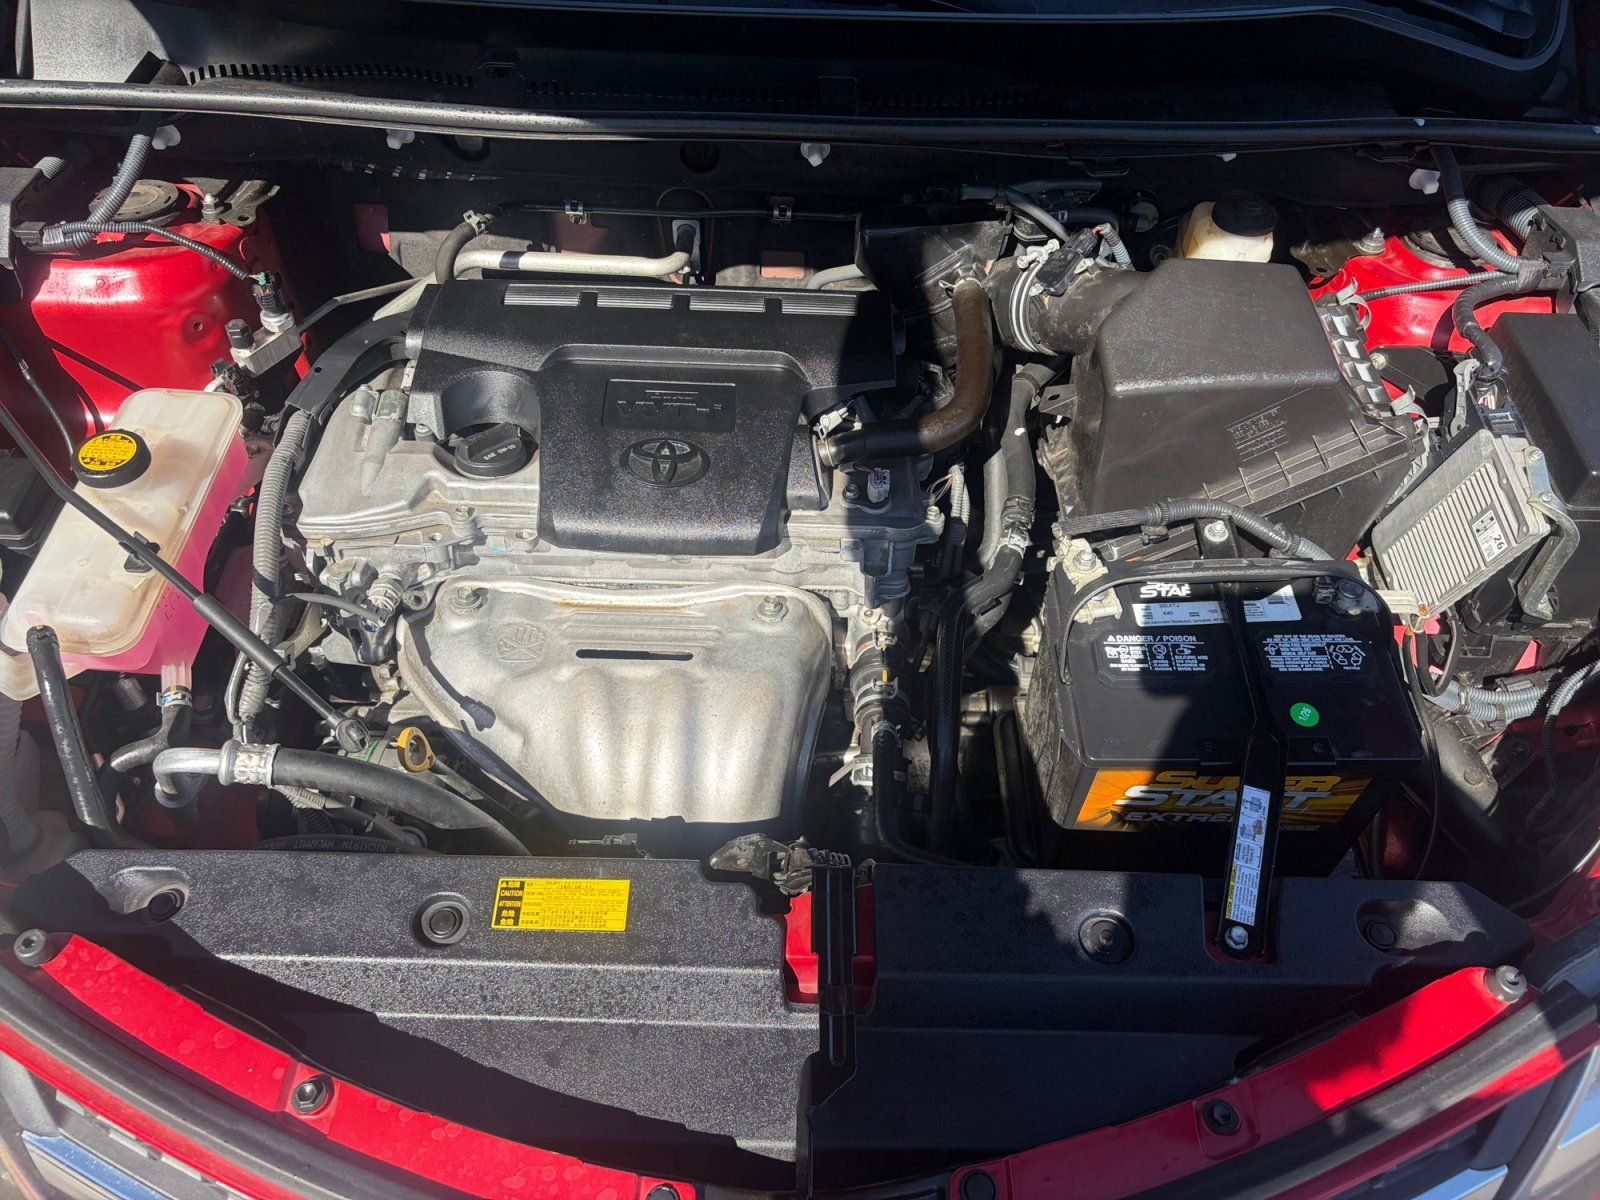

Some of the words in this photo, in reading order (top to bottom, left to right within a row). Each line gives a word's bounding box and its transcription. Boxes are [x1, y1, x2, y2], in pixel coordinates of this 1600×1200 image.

[1115, 634, 1154, 642] DANGER
[1155, 770, 1341, 792] SUER
[1114, 785, 1331, 808] STAT
[500, 889, 523, 897] CAUTION
[498, 900, 522, 908] ATTENTION
